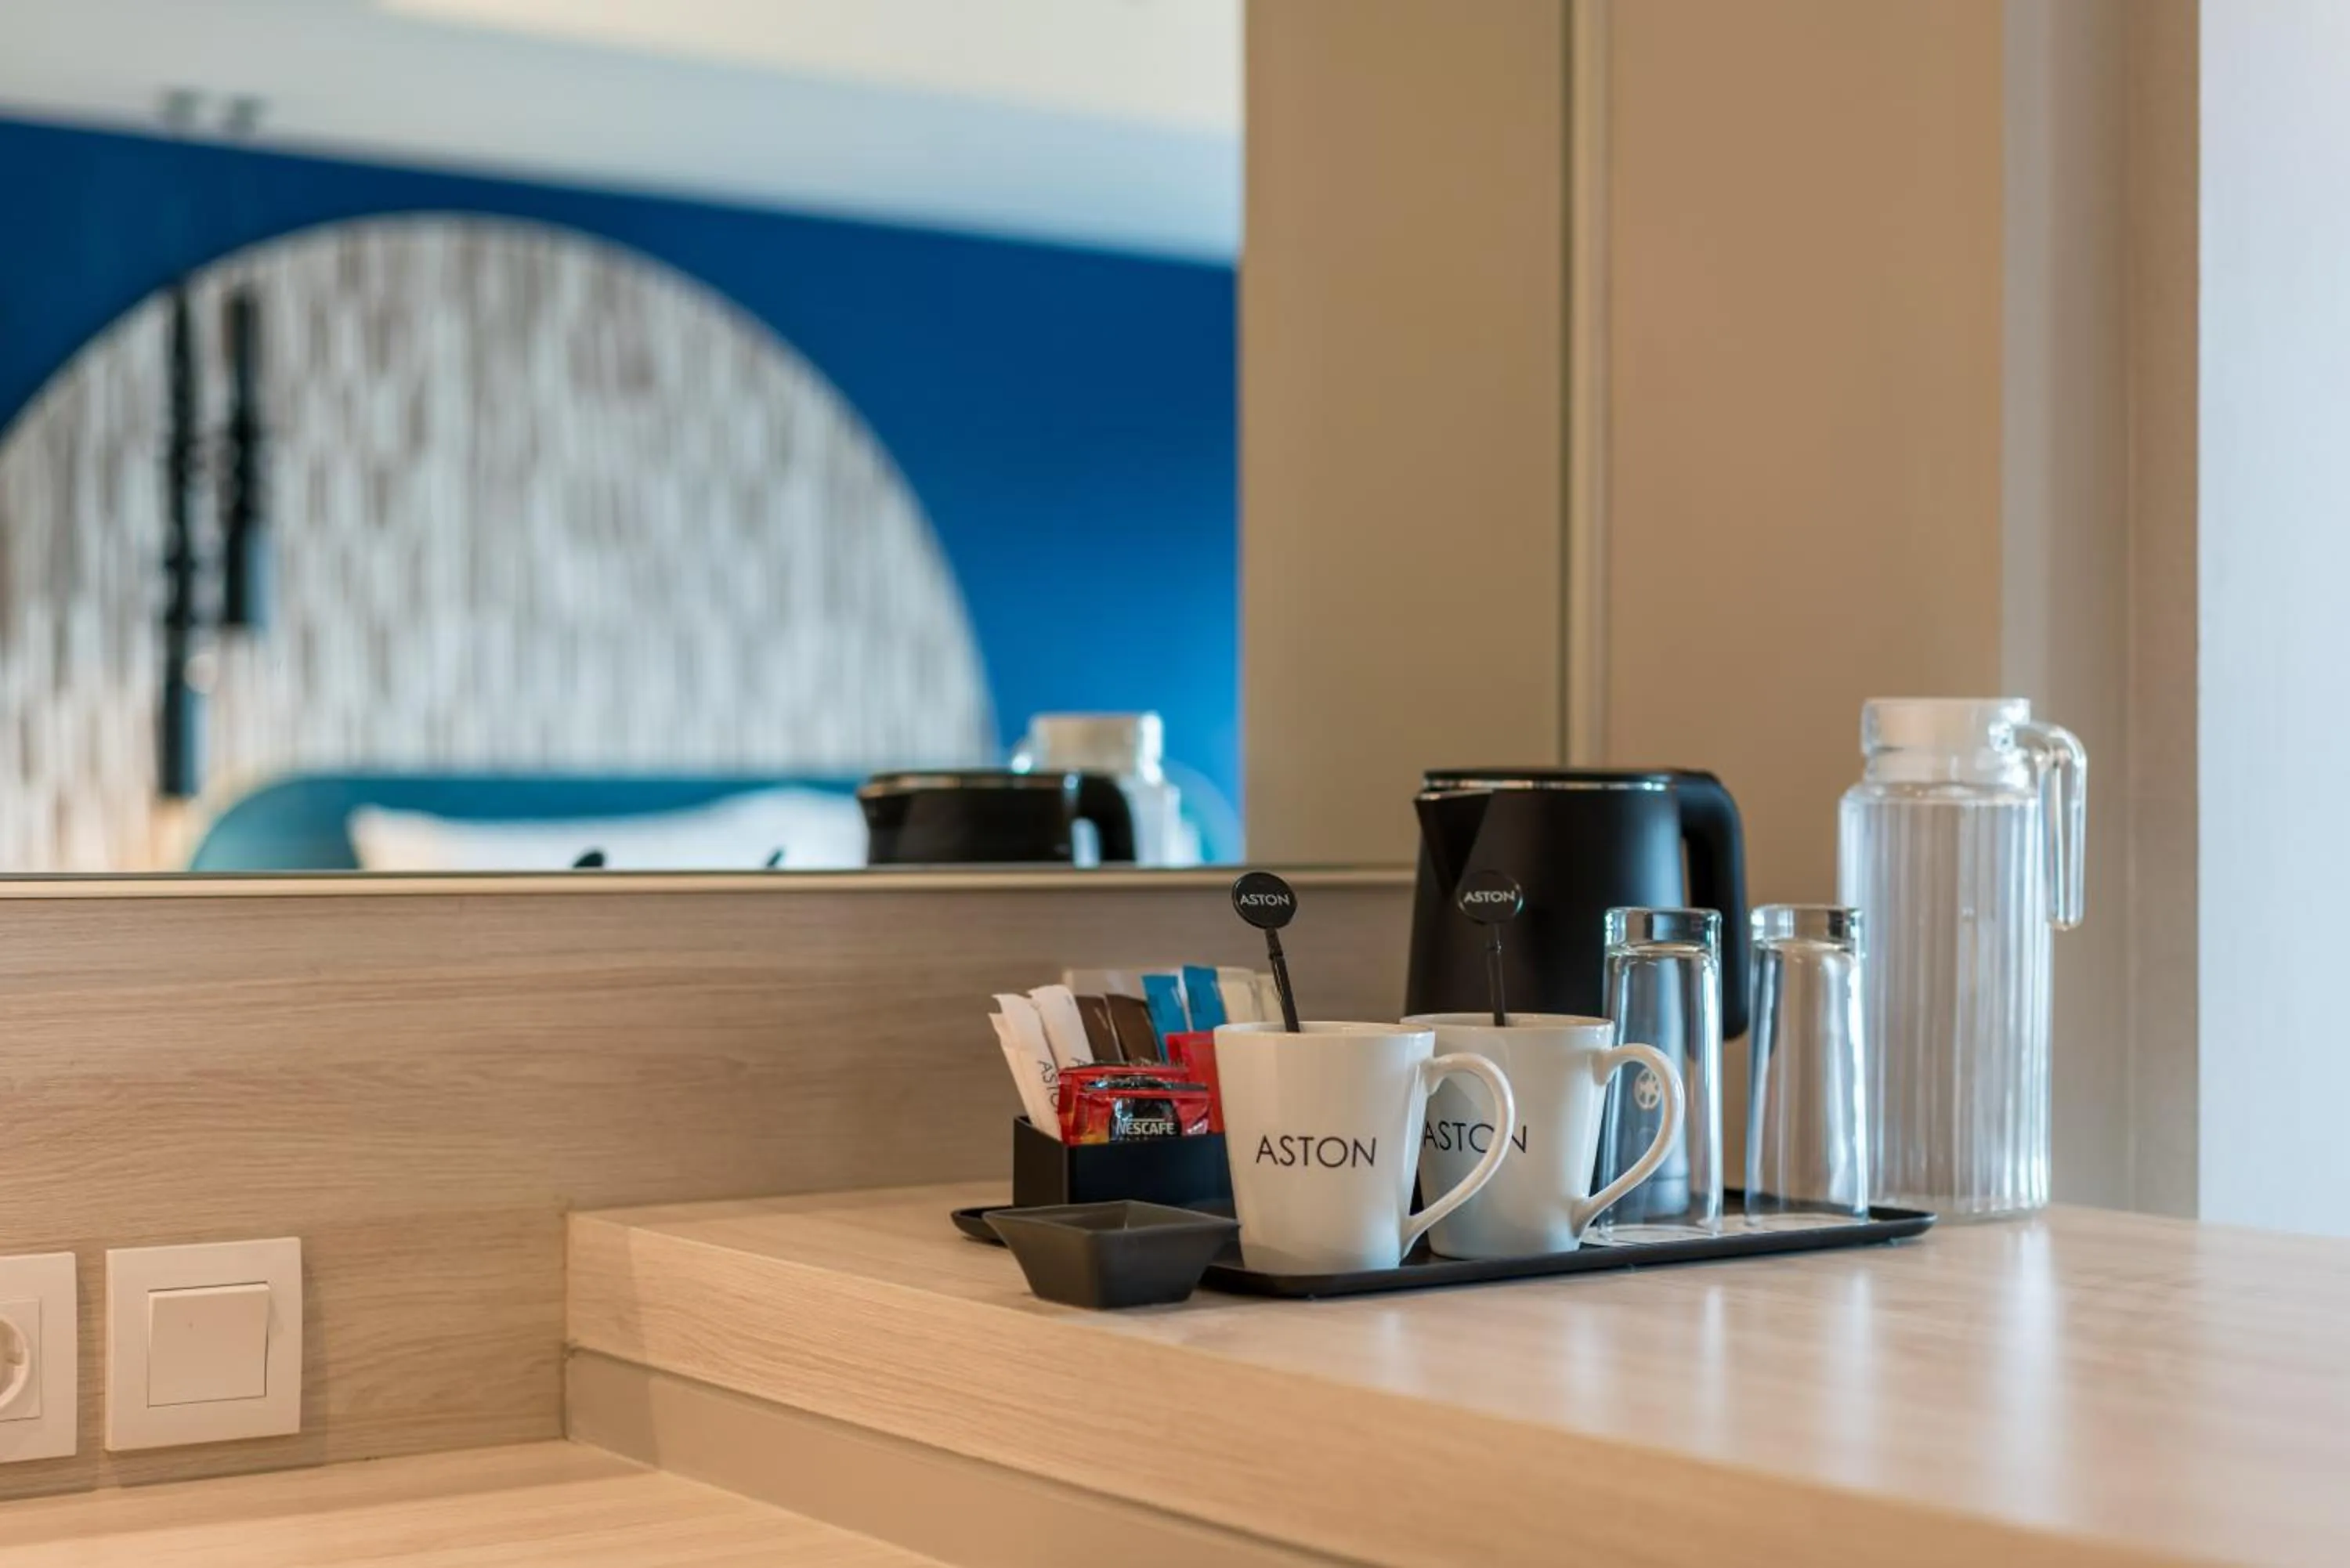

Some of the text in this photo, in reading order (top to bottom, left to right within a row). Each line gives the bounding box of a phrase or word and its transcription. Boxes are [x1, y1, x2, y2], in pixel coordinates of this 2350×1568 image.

[1241, 894, 1290, 905] ASTON
[1463, 890, 1515, 902] ASTON
[1256, 1135, 1376, 1168] ASTON
